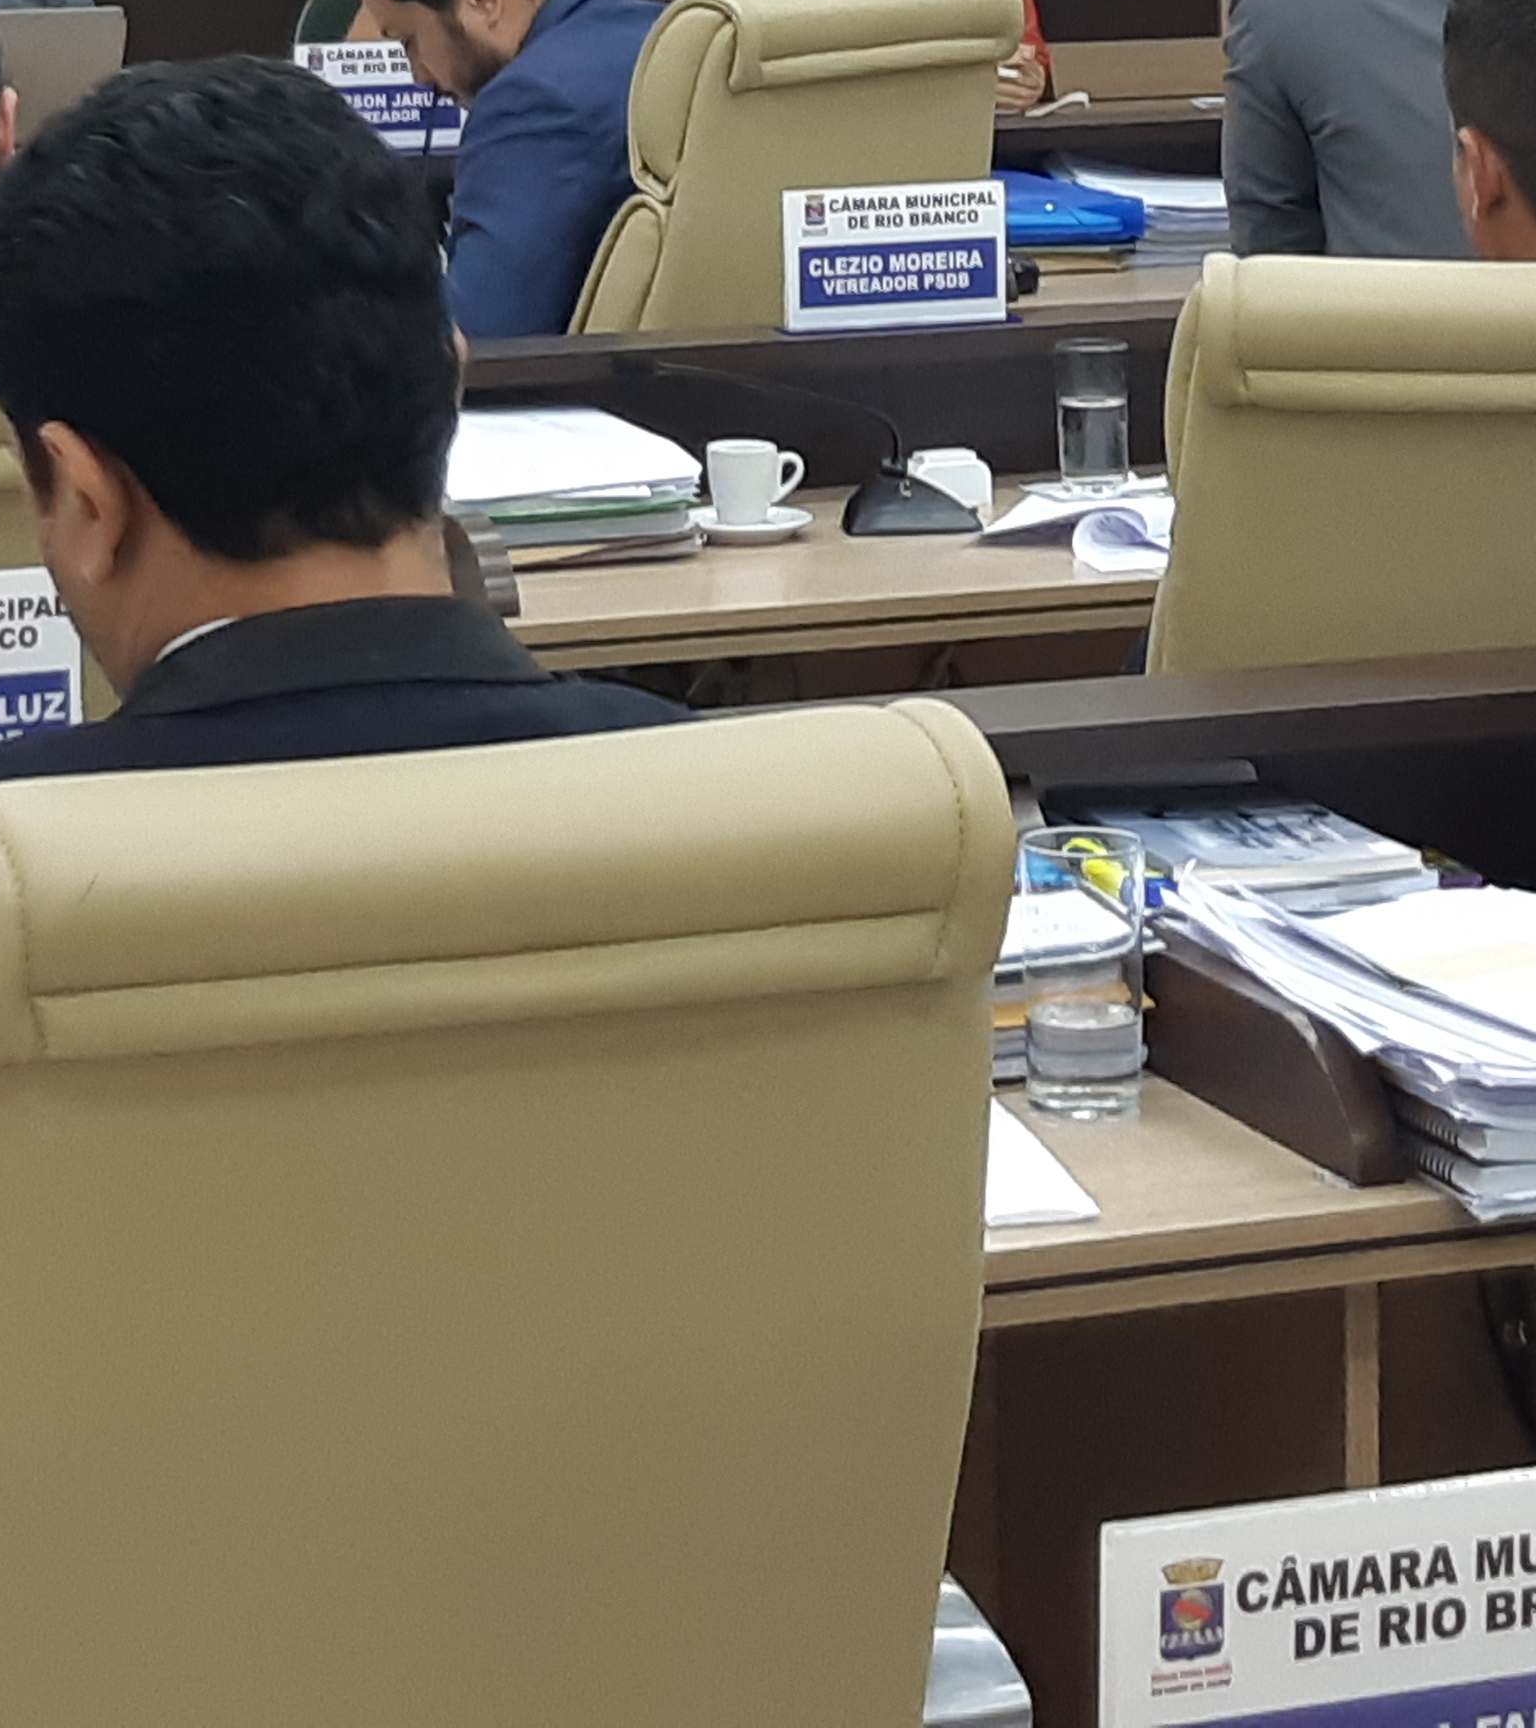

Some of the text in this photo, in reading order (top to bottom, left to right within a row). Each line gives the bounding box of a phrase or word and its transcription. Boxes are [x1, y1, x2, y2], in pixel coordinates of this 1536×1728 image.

[829, 189, 997, 213] CÂMARA MUNICIPAL
[848, 209, 979, 229] DE RIO BRANCO
[809, 248, 984, 278] CLEZIO MOREIRA
[823, 273, 919, 297] VEREADOR
[1236, 1544, 1460, 1615] CÂMARA
[1293, 1616, 1360, 1663] DE
[1378, 1599, 1466, 1650] RIO
